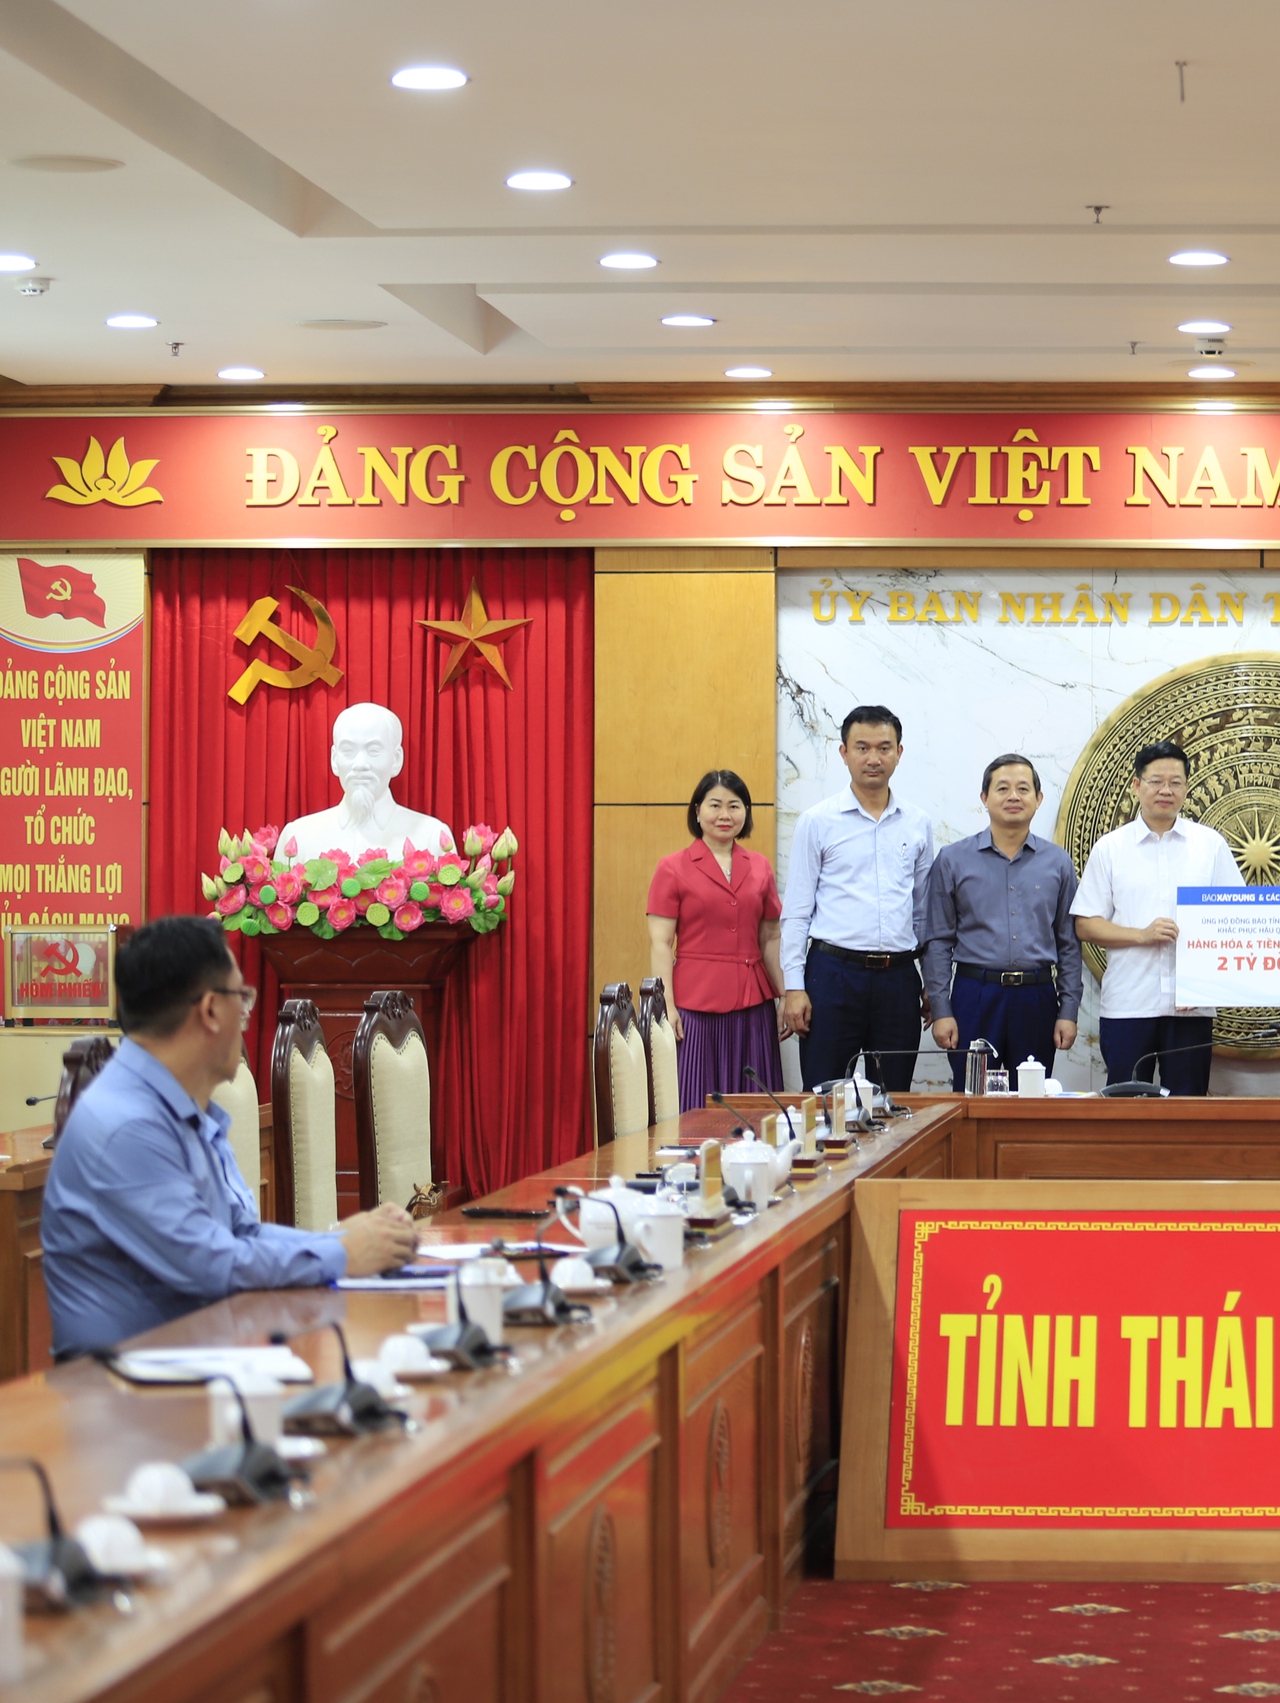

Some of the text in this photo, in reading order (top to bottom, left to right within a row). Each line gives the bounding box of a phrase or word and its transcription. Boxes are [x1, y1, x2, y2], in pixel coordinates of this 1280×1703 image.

[243, 424, 466, 507] ĐẢNG
[489, 429, 700, 522] CỘNG
[720, 422, 883, 507] SẢN
[908, 428, 1102, 523] VIỆT
[809, 577, 873, 623] ỦY
[886, 591, 982, 623] BAN
[997, 583, 1132, 624] NHÂN
[1148, 583, 1247, 624] DÂN
[0, 657, 131, 706] ẢNG CỘNG SẢN
[20, 712, 101, 755] VIỆT NAM
[0, 759, 133, 804] GƯỜI LÃNH ĐẠO,
[24, 804, 96, 846] TỔ CHỨC
[0, 854, 122, 901] MỌI THẮNG LỢI
[1187, 938, 1218, 949] HÀNG
[1220, 938, 1243, 949] HÓA
[1246, 940, 1254, 949] &
[1257, 937, 1280, 949] TIỀN
[1217, 956, 1228, 971] 2
[1234, 953, 1258, 971] TỶ
[20, 979, 53, 998] HÒM
[940, 1273, 1098, 1428] TỈNH
[1120, 1290, 1275, 1430] THÁI
